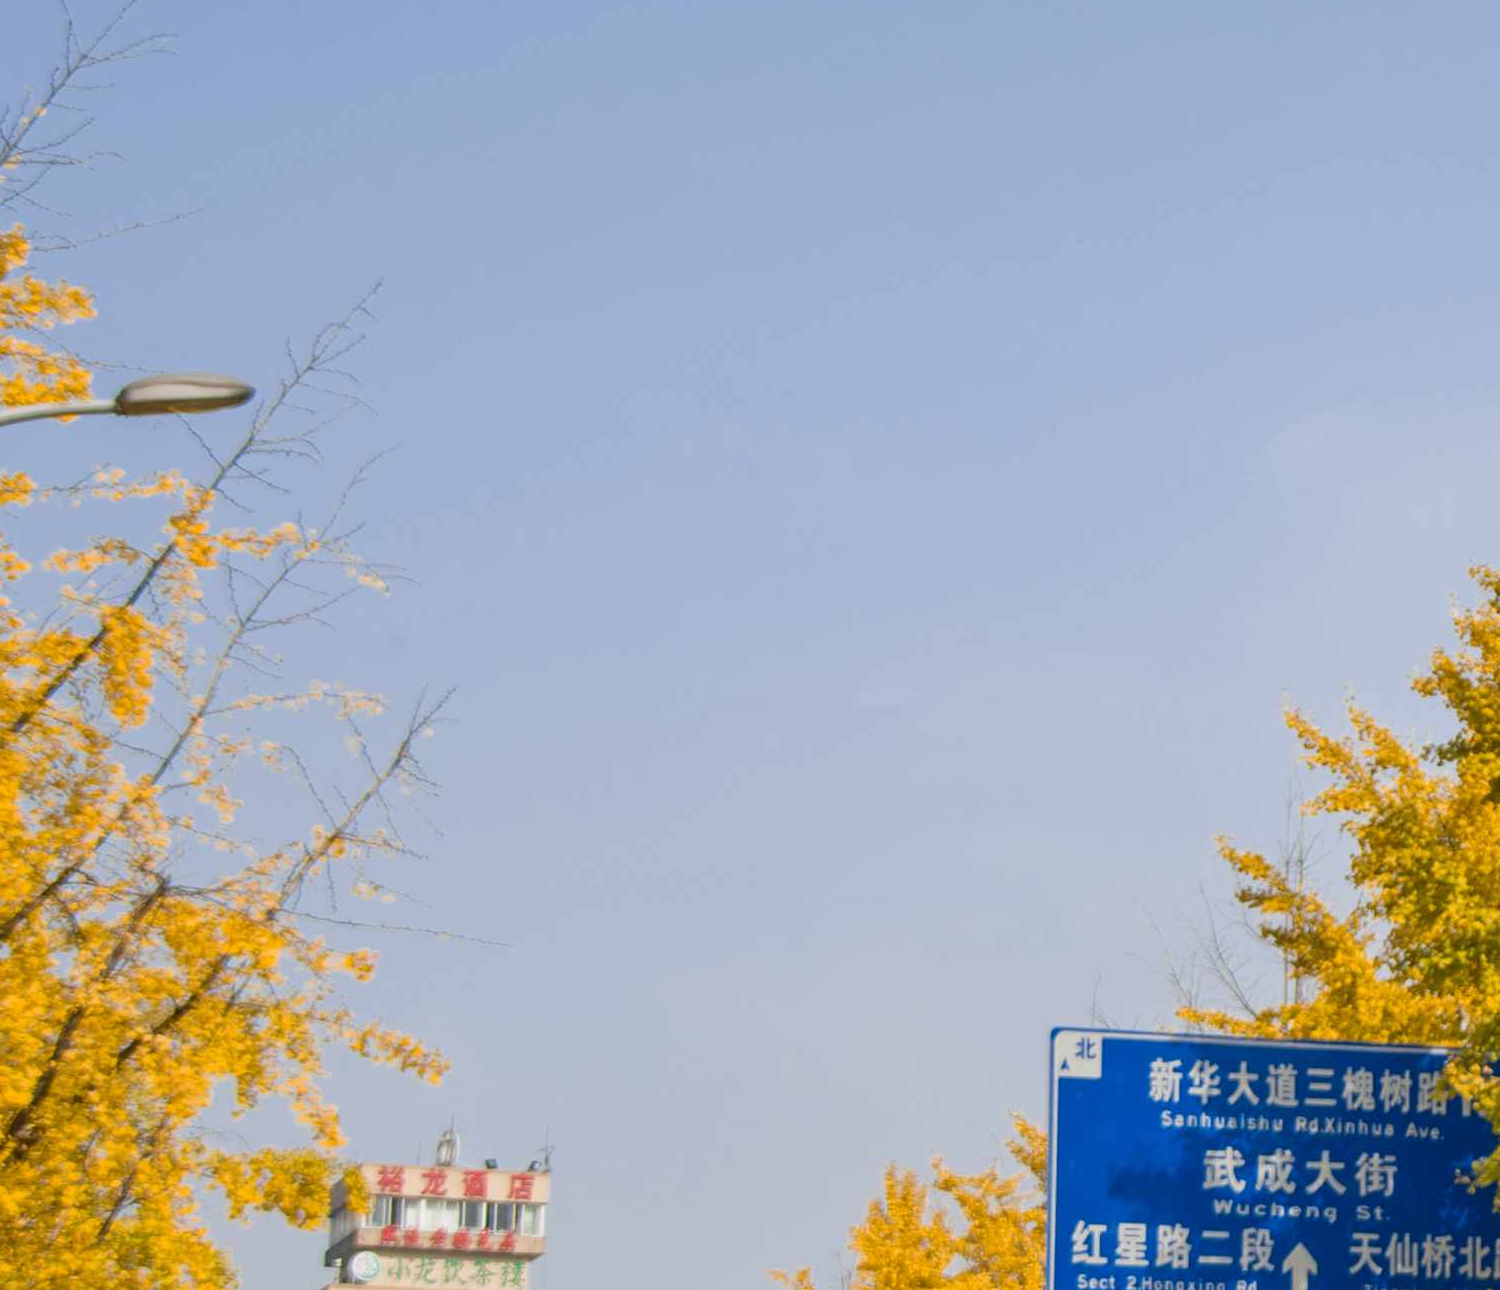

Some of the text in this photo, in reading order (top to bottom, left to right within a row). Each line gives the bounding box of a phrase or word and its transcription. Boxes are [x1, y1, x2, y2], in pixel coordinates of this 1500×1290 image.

[1075, 1037, 1097, 1059] 北
[1148, 1056, 1475, 1118] 新华大道三槐树路
[1160, 1109, 1283, 1132] Sanhuaishu
[1405, 1122, 1445, 1140] Ave.
[1203, 1145, 1398, 1197] 武成大街
[1213, 1199, 1391, 1223] Wucheng St.
[1071, 1219, 1276, 1272] 红星路二段
[1077, 1274, 1117, 1290] Sect
